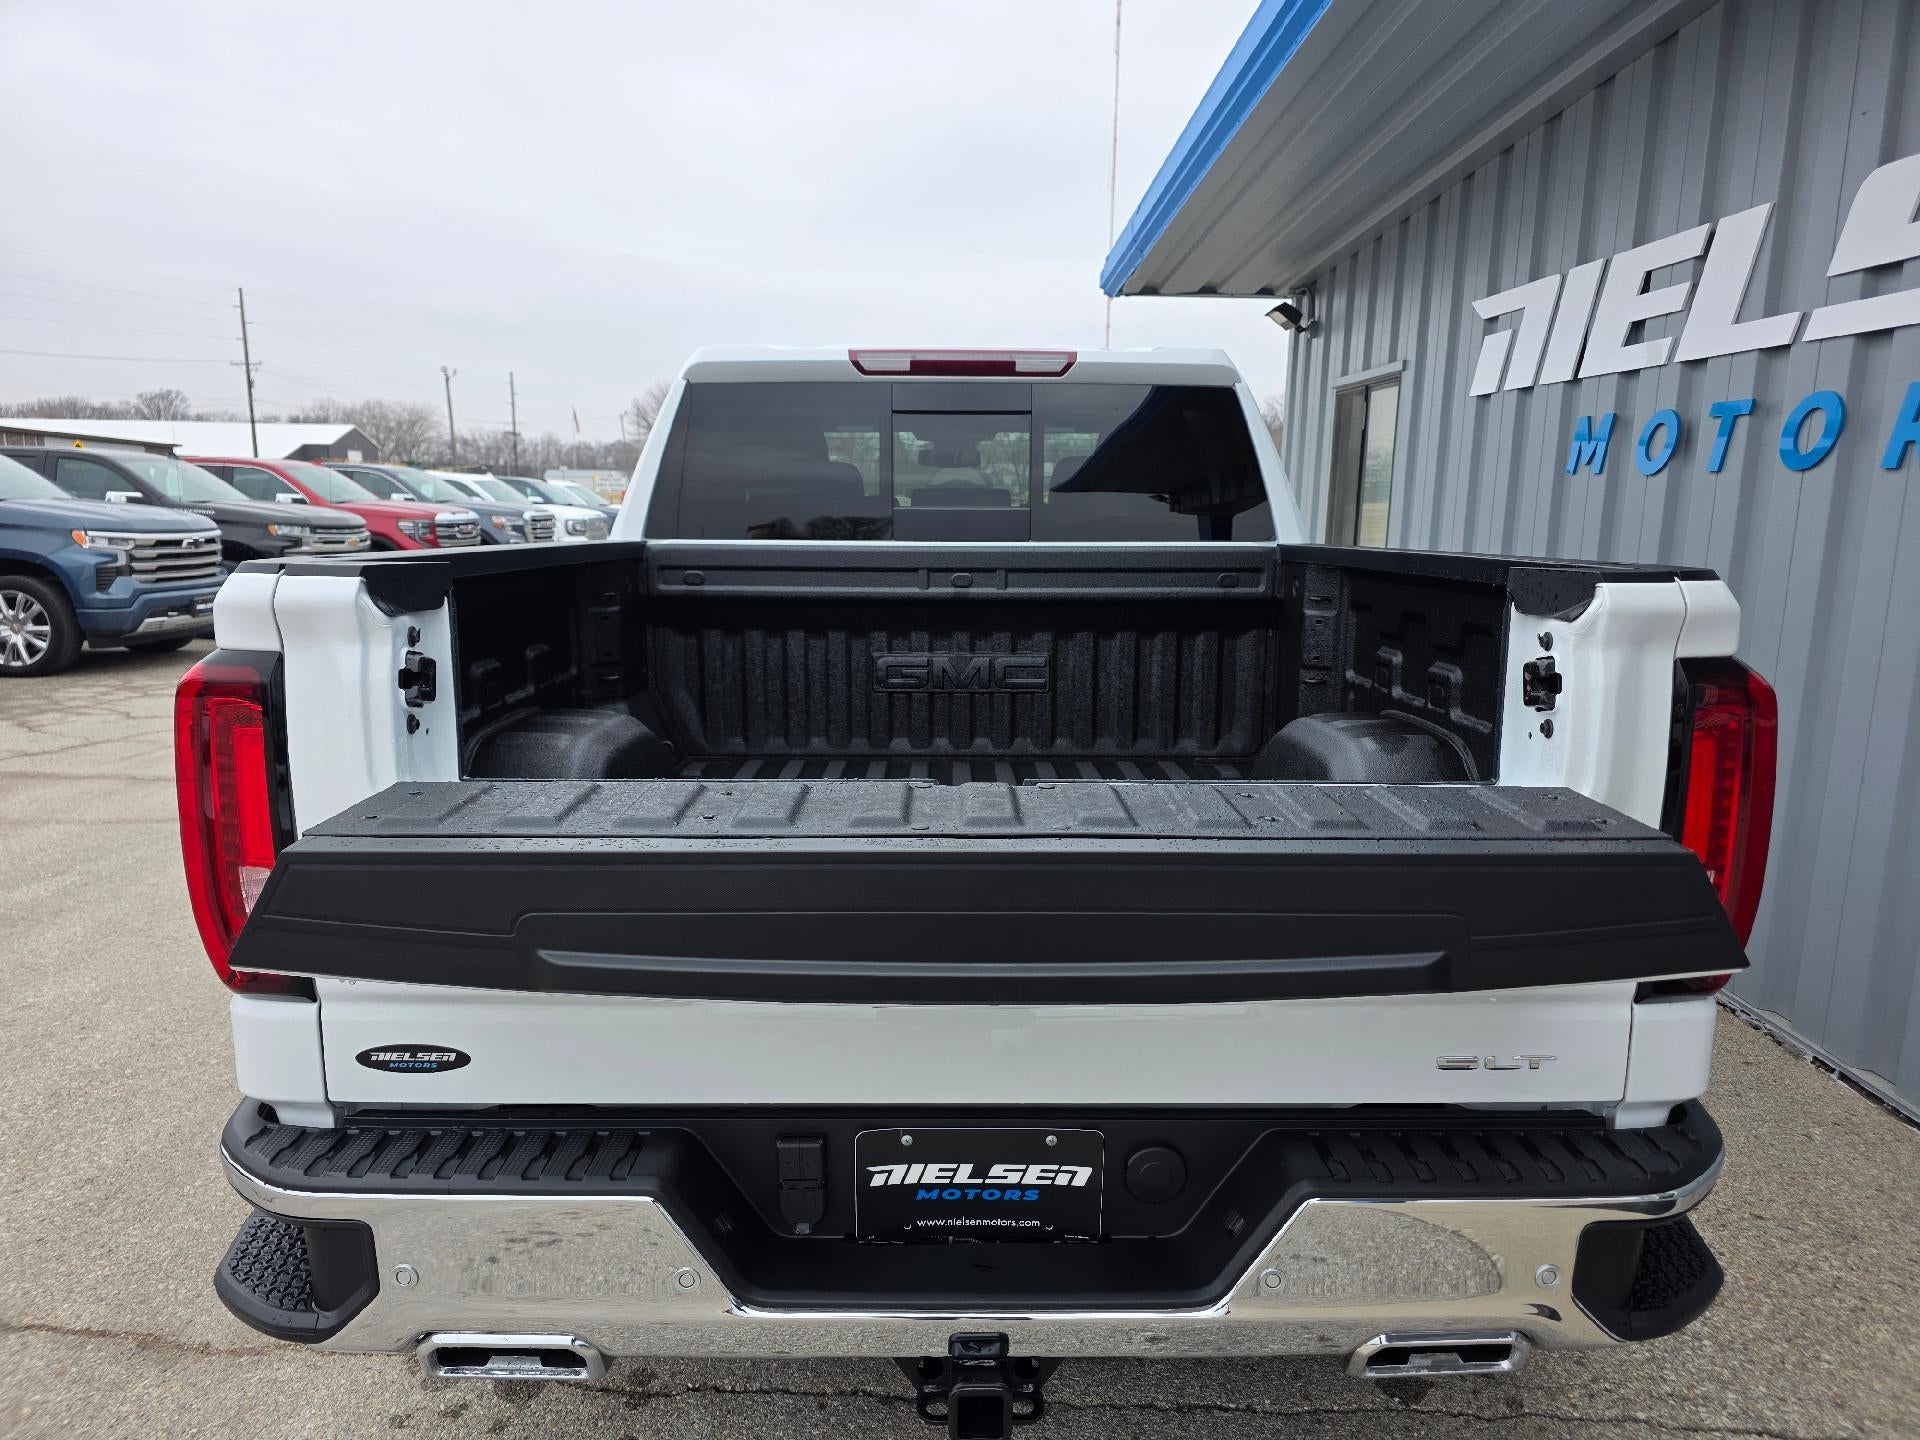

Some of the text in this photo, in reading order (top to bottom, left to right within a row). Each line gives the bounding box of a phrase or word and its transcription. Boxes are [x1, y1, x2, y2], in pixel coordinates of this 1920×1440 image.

[876, 656, 1047, 689] GMC
[370, 1052, 457, 1061] NIELSEN
[1437, 1055, 1557, 1070] SLT
[866, 1163, 1093, 1187] NIELSEN
[916, 1188, 1040, 1200] MOTORS
[916, 1216, 1040, 1227] www.nielsenmotors.com
